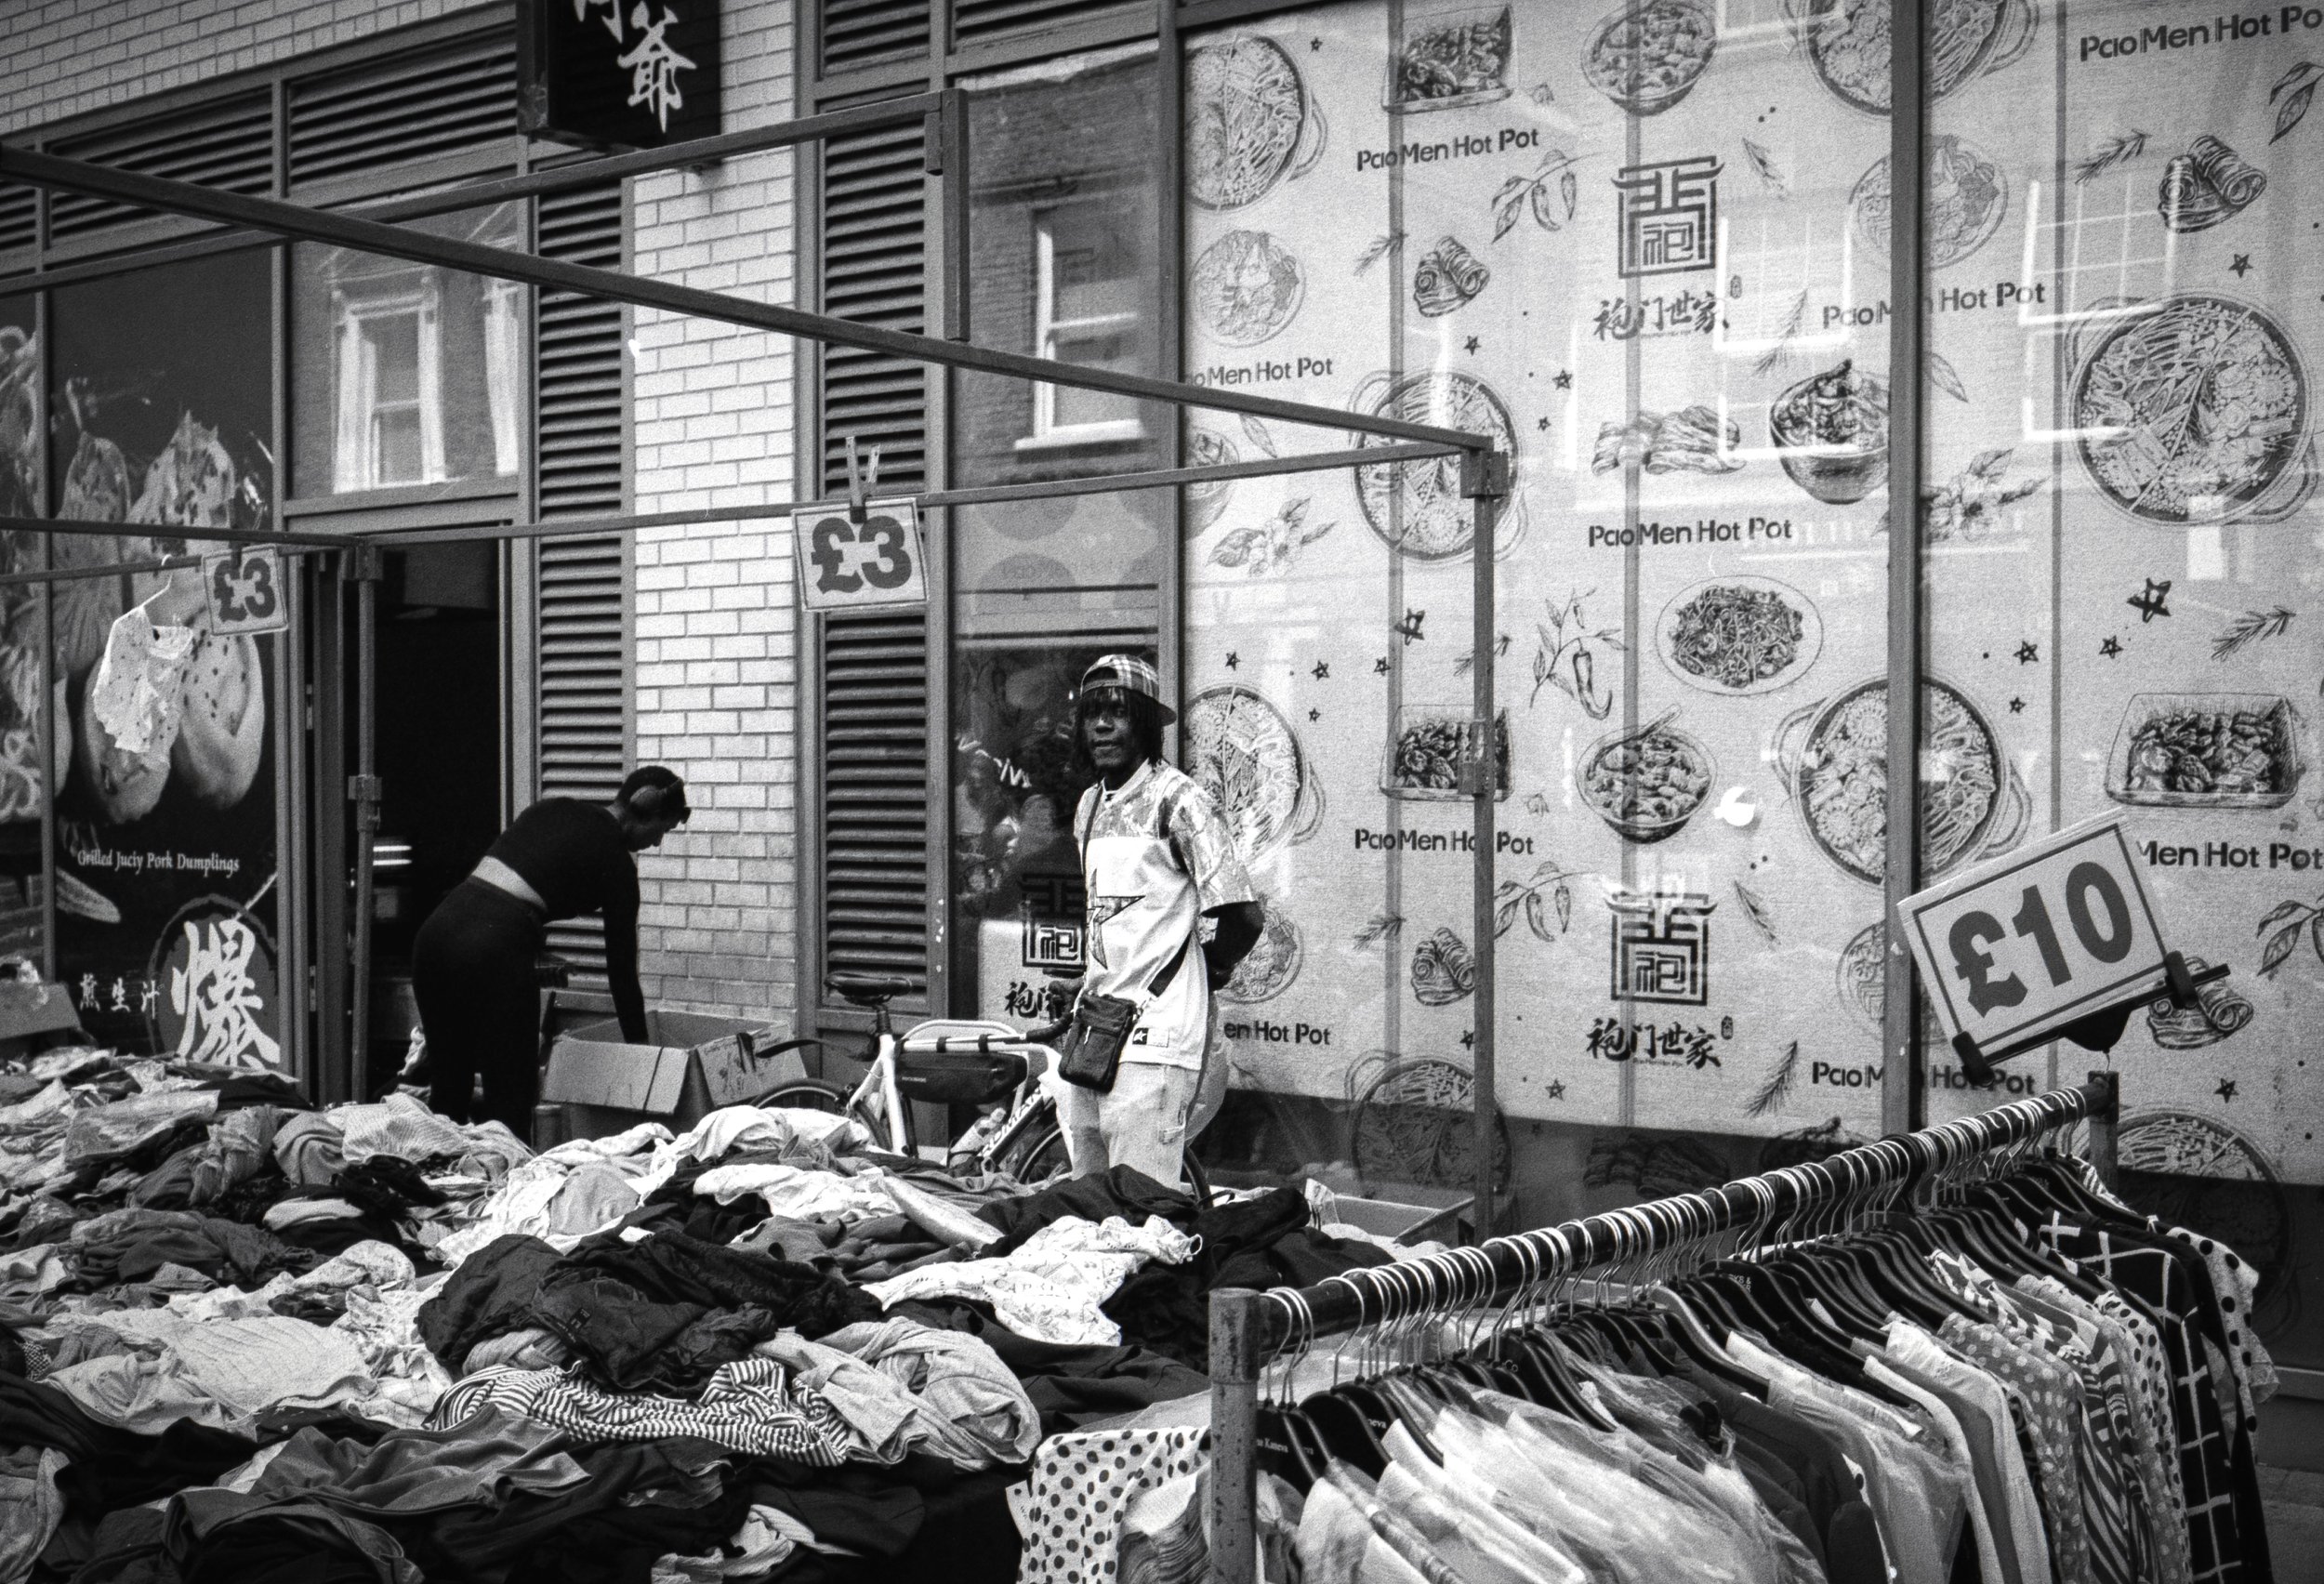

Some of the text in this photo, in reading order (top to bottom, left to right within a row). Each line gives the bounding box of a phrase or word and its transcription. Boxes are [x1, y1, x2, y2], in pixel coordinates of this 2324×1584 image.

[2215, 14, 2271, 43] Hot
[2280, 6, 2323, 33] Po
[1454, 135, 1492, 158] Hot
[1499, 128, 1538, 152] Pot
[1939, 287, 1987, 312] Hot
[1997, 282, 2046, 308] Pot
[1257, 361, 1291, 381] Hot
[1298, 357, 1333, 378] Pot
[1697, 520, 1740, 542] Hot
[1749, 517, 1792, 540] Pot
[811, 515, 912, 595] £3
[214, 558, 275, 622] £3
[1497, 831, 1534, 855] Pot
[2204, 841, 2260, 868] Hot
[2269, 842, 2323, 870] Pot
[146, 850, 174, 869] Pork
[177, 851, 241, 878] Dumplings
[1949, 862, 2133, 1019] £10
[1224, 1021, 1330, 1045] en Hot Pot
